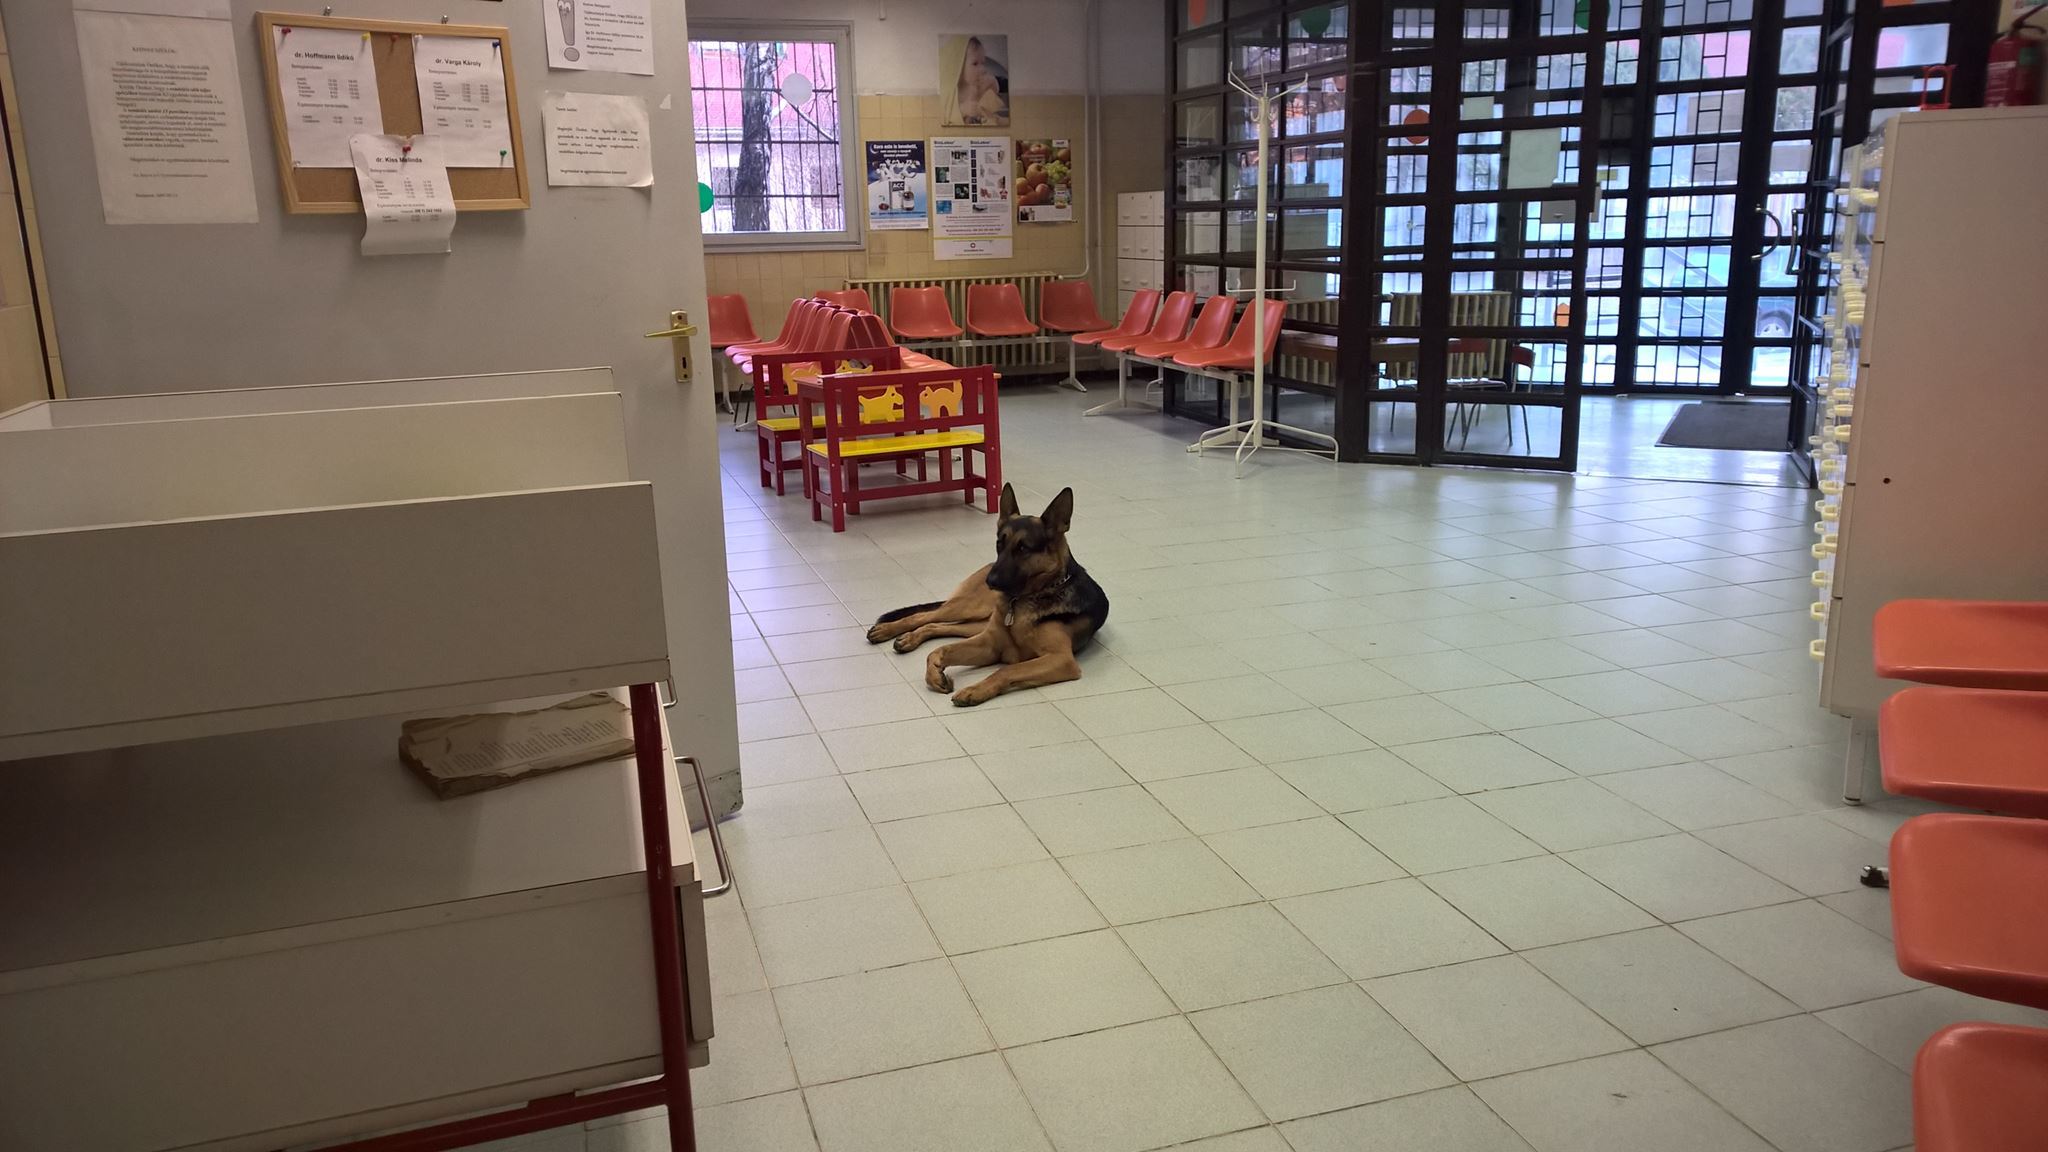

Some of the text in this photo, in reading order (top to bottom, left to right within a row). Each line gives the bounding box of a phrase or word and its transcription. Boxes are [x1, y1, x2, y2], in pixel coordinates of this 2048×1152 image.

[304, 52, 336, 60] Hoffmann
[445, 58, 462, 66] Varga
[463, 58, 481, 67] Károly
